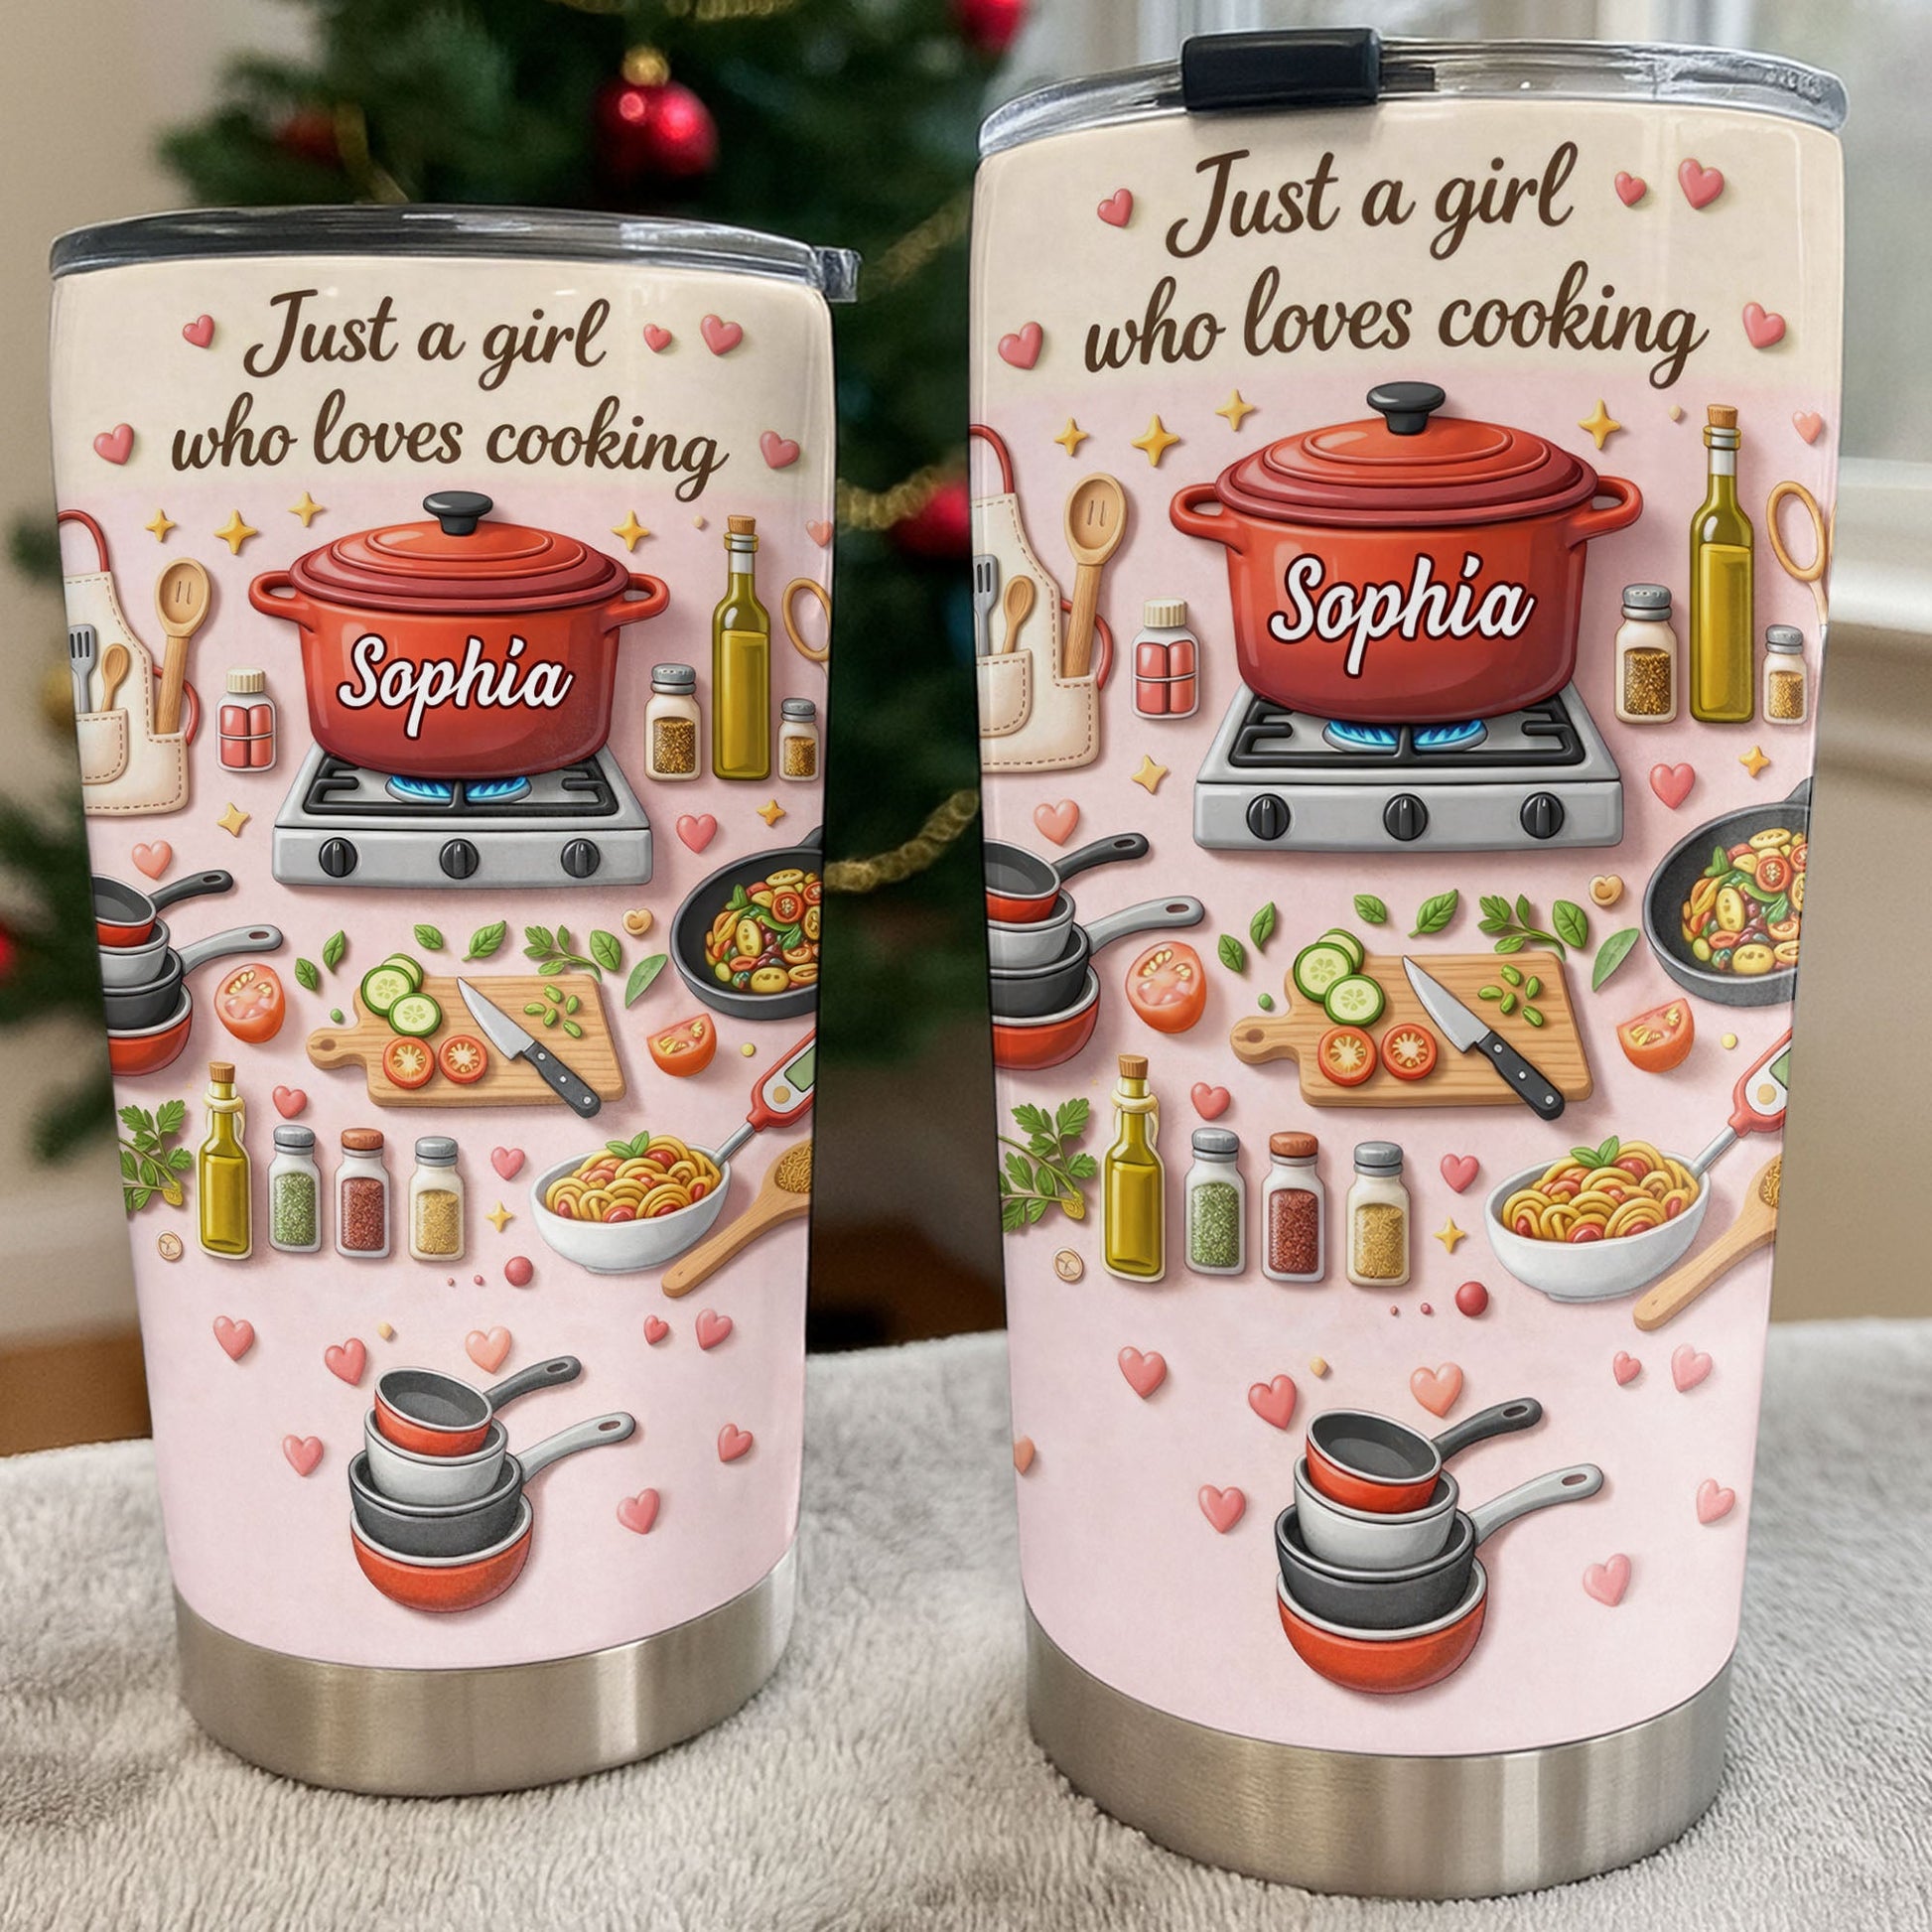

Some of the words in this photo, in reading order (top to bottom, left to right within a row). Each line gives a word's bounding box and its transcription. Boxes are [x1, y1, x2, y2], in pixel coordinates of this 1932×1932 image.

[1165, 149, 1341, 258] Just
[1360, 179, 1417, 227] a
[1429, 141, 1579, 261] girl
[242, 289, 400, 378] Just
[416, 321, 467, 361] a
[478, 298, 611, 391] girl
[1084, 276, 1227, 374] who
[1243, 265, 1413, 356] loves
[1438, 260, 1711, 388] cooking
[171, 391, 299, 472] who
[313, 388, 465, 465] loves
[485, 395, 730, 502] cooking
[1268, 552, 1538, 679] Sophia
[337, 633, 575, 740] Sophia
